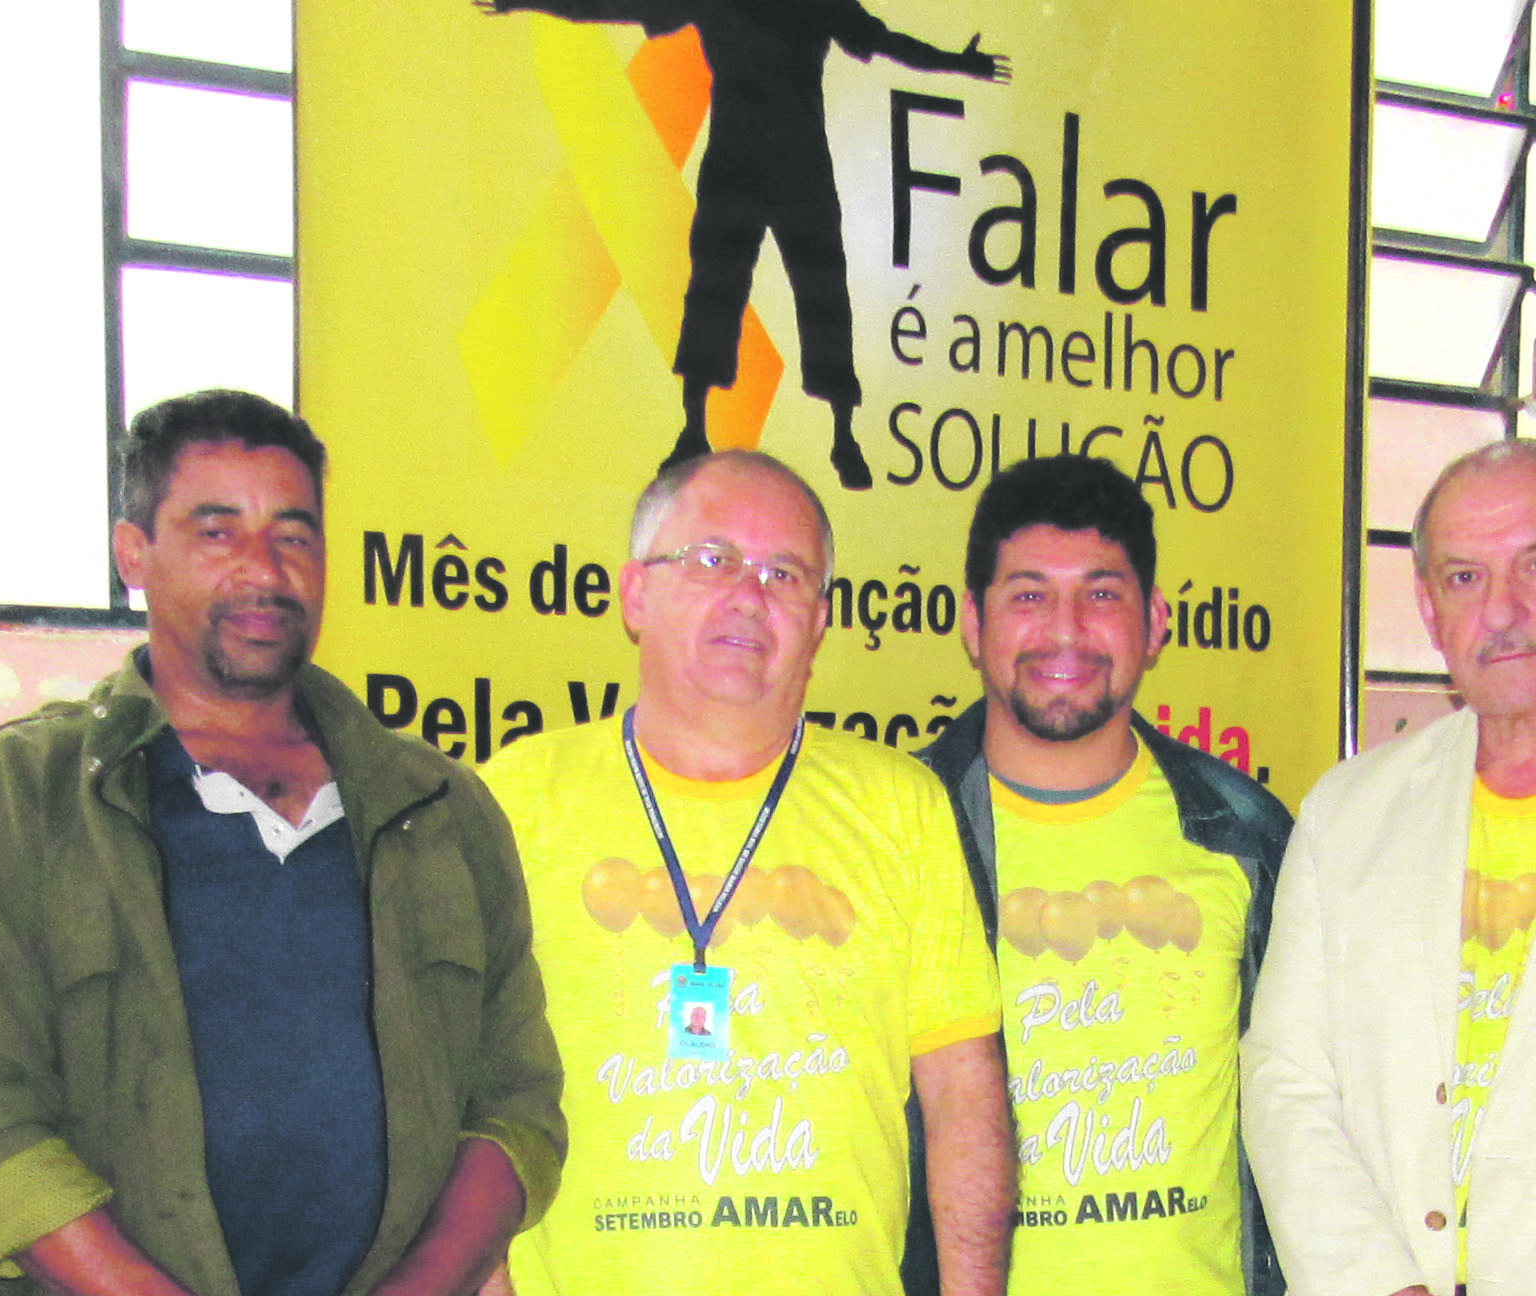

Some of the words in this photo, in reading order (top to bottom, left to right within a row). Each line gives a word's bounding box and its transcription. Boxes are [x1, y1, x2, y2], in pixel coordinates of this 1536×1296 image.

[887, 88, 1238, 313] Falar
[890, 284, 927, 366] é
[949, 313, 981, 374] a
[997, 310, 1235, 401] melhor
[364, 530, 508, 612] Mês
[529, 544, 611, 618] de
[1015, 979, 1124, 1044] Pela
[596, 1032, 850, 1104] Valorização
[1008, 1035, 1198, 1104] alorização
[626, 1116, 676, 1163] da
[680, 1094, 821, 1187] Vida
[1045, 1096, 1173, 1187] Vida
[593, 1195, 701, 1210] CAMPANHA
[594, 1211, 703, 1232] SETEMBRO
[711, 1195, 859, 1228] AMARELO
[1075, 1186, 1209, 1225] AMARELO
